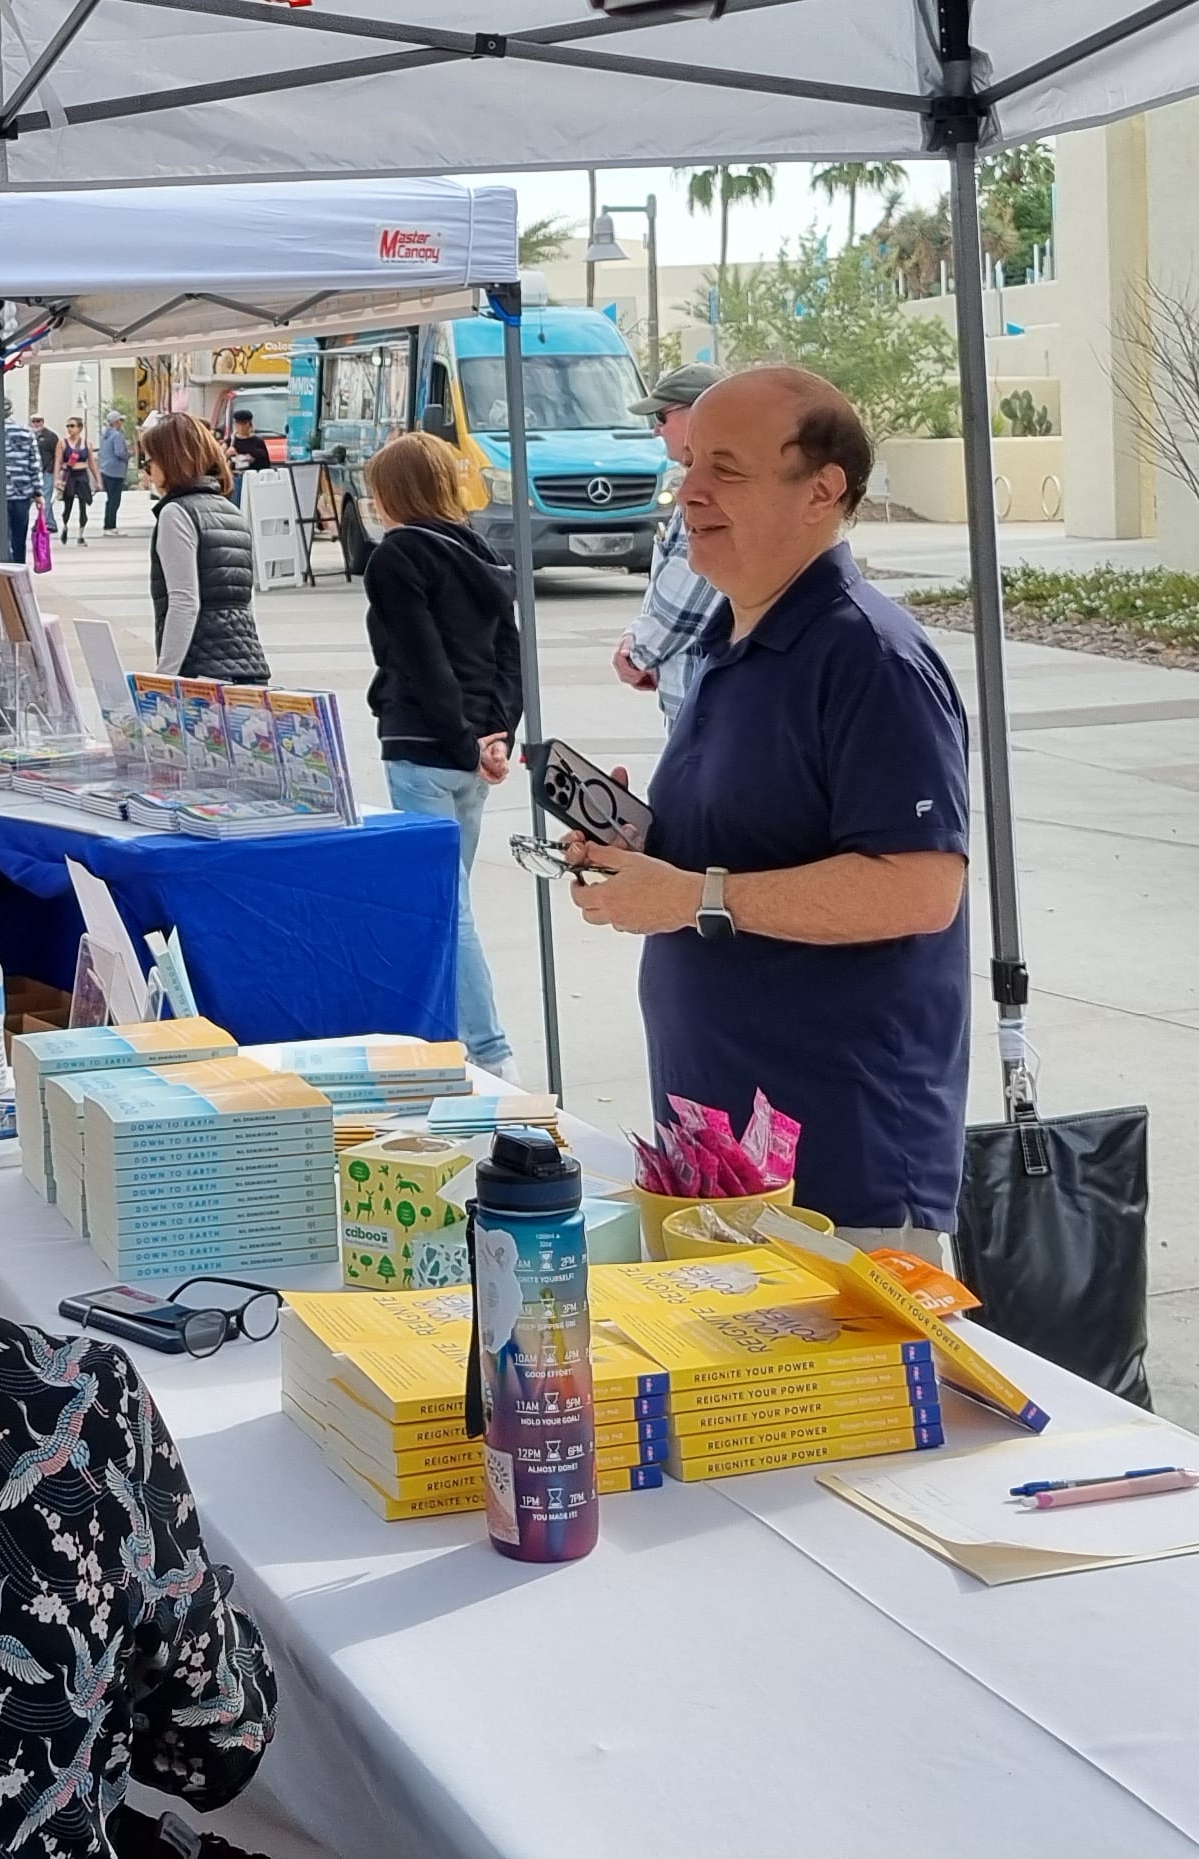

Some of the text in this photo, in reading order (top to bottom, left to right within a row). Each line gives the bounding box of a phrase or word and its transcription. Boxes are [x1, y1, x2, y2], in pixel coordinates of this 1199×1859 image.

[380, 229, 430, 258] Master
[397, 244, 440, 263] Canopy
[56, 1060, 85, 1069] DOWN
[90, 1059, 101, 1067] TO
[104, 1057, 132, 1065] EARTH
[131, 1123, 161, 1131] DOWN
[184, 1119, 215, 1127] EARTH
[133, 1139, 164, 1148] DOWN
[186, 1135, 217, 1143] EARTH
[134, 1156, 165, 1164] DOWN
[188, 1151, 218, 1159] EARTH
[134, 1172, 165, 1180] DOWN
[187, 1168, 217, 1176] EARTH
[133, 1188, 164, 1196] DOWN
[186, 1183, 217, 1192] EARTH
[136, 1204, 167, 1212] DOWN
[136, 1236, 167, 1244] DOWN
[190, 1231, 219, 1239] EARTH
[136, 1252, 168, 1260] DOWN
[190, 1247, 220, 1255] EARTH
[561, 1255, 576, 1267] 2PM
[137, 1268, 169, 1276] DOWN
[191, 1263, 221, 1271] EARTH
[617, 1266, 692, 1305] REIGNITE
[657, 1270, 710, 1295] YOUR
[679, 1265, 744, 1295] POWER
[412, 1301, 459, 1325] YOUR
[562, 1302, 577, 1314] 3PM
[868, 1270, 906, 1306] REIGNITE
[907, 1303, 931, 1327] YOUR
[931, 1324, 961, 1353] POWER
[372, 1296, 442, 1336] REIGNITE
[690, 1307, 773, 1354] REIGNITE
[732, 1313, 789, 1342] YOUR
[755, 1307, 828, 1344] POWER
[514, 1353, 537, 1363] 10AM
[524, 1370, 546, 1378] GOOD
[694, 1361, 815, 1382] REIGNITE YOUR POWER
[697, 1383, 818, 1405] REIGNITE YOUR POWER
[421, 1401, 464, 1414] REIGNIT
[515, 1400, 539, 1411] 11AM
[521, 1418, 541, 1426] HOLD
[542, 1417, 561, 1425] YOUR
[701, 1403, 821, 1427] REIGNITE YOUR POWER
[708, 1426, 827, 1450] REIGNITE YOUR POWER
[517, 1444, 583, 1458] 12PM 6PM
[424, 1452, 473, 1467] REIGNITE
[708, 1448, 828, 1472] REIGNITE YOUR POWER
[527, 1465, 556, 1473] ALMOST
[427, 1476, 476, 1491] REIGNITE
[411, 1496, 460, 1511] REIGNITE
[522, 1492, 585, 1506] 1PM 7PM
[532, 1513, 548, 1521] YOU
